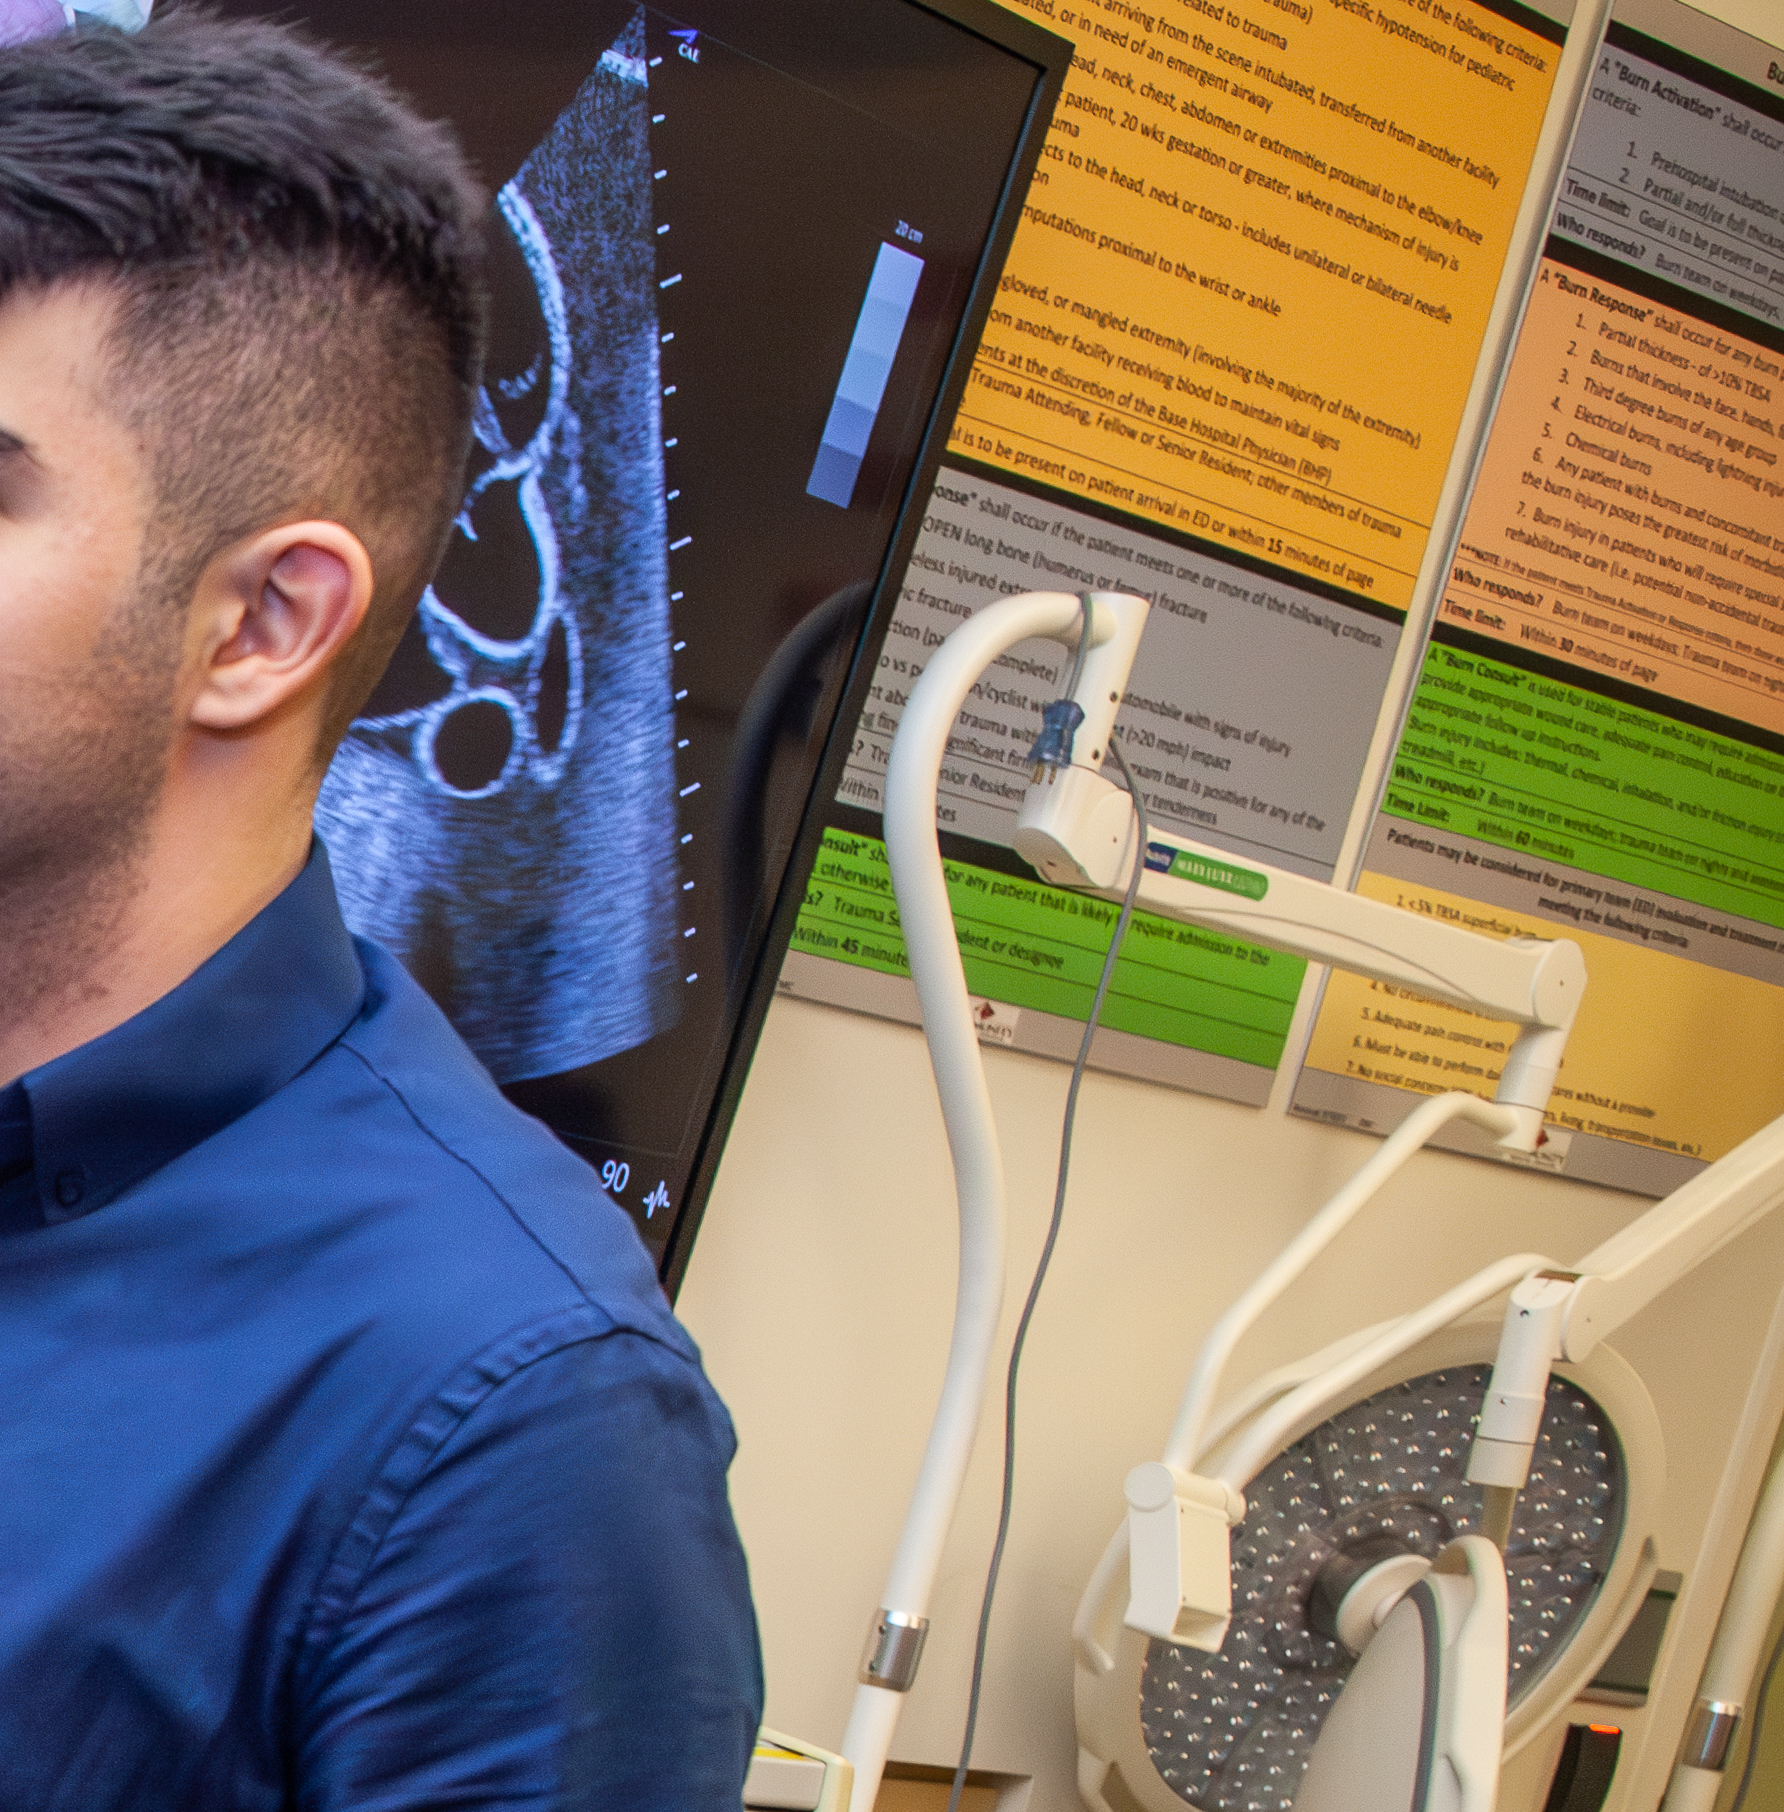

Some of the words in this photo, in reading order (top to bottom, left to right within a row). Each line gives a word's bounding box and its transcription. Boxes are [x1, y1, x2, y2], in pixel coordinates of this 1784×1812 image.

[1060, 10, 1074, 25] or
[1078, 14, 1091, 32] in
[1094, 24, 1128, 48] need
[1130, 40, 1146, 55] of
[1147, 48, 1164, 63] an
[1166, 56, 1229, 92] emergent
[1231, 83, 1273, 114] airway
[1226, 11, 1240, 28] to
[1242, 18, 1287, 50] trauma
[1376, 12, 1447, 57] hypotension
[1448, 47, 1465, 66] for
[1466, 58, 1515, 91] pediatric
[1417, 0, 1431, 13] of
[1432, 4, 1452, 24] the
[1453, 15, 1505, 54] following
[1157, 17, 1189, 44] from
[1192, 34, 1214, 55] the
[1215, 48, 1252, 73] scene
[1254, 61, 1315, 105] intubated,
[1320, 92, 1387, 133] transferred
[1387, 122, 1416, 147] from
[1417, 139, 1463, 168] another
[1463, 157, 1500, 189] facility
[1600, 57, 1609, 74] A
[1615, 62, 1650, 91] "Burn
[1651, 80, 1720, 119] Activation"
[1722, 113, 1750, 136] shall
[1068, 51, 1097, 79] ead,
[1102, 67, 1135, 94] neck,
[1140, 83, 1177, 112] chest,
[1181, 101, 1241, 136] abdomen
[1243, 130, 1257, 143] or
[1260, 136, 1327, 175] extremities
[1328, 166, 1381, 198] proximal
[1382, 188, 1395, 205] to
[1397, 195, 1416, 215] the
[1065, 92, 1116, 126] patient,
[1120, 112, 1138, 132] 20
[1141, 123, 1165, 144] wks
[1166, 135, 1226, 169] gestation
[1228, 162, 1242, 176] or
[1243, 168, 1291, 199] greater,
[1296, 190, 1333, 216] where
[1335, 207, 1400, 245] mechanism
[1402, 237, 1415, 250] of
[1416, 240, 1448, 269] injury
[1449, 255, 1459, 272] is
[1643, 178, 1684, 207] Partial
[1684, 199, 1725, 226] and/or
[1726, 213, 1746, 233] full
[1651, 151, 1719, 192] Prehospital
[1719, 181, 1779, 219] intubation
[1020, 201, 1096, 243] mputations
[1097, 235, 1157, 267] proximal
[1158, 256, 1172, 273] to
[1175, 263, 1196, 283] the
[1199, 275, 1230, 296] wrist
[1231, 288, 1246, 301] or
[1247, 294, 1281, 316] ankle
[1041, 139, 1064, 162] cts
[1068, 151, 1082, 169] to
[1085, 158, 1107, 179] the
[1110, 167, 1145, 197] head,
[1149, 187, 1179, 208] neck
[1182, 201, 1196, 214] or
[1198, 206, 1232, 230] torso
[1242, 223, 1291, 255] includes
[1294, 247, 1350, 279] unilateral
[1351, 272, 1364, 285] or
[1366, 275, 1414, 306] bilateral
[1414, 299, 1452, 324] needle
[1557, 212, 1585, 235] Who
[1586, 228, 1645, 259] responds?
[1540, 268, 1549, 283] A
[1554, 272, 1588, 298] "Burn
[1589, 288, 1653, 322] Response"
[1654, 315, 1681, 335] shall
[1682, 329, 1712, 348] occur
[1714, 338, 1731, 355] for
[1732, 349, 1752, 367] any
[1753, 354, 1779, 376] burn
[1002, 274, 1049, 305] gloved,
[1053, 295, 1069, 309] or
[1071, 302, 1129, 333] mangled
[1130, 324, 1191, 360] extremity
[1193, 346, 1252, 384] (involving
[1254, 371, 1275, 390] the
[1277, 381, 1326, 412] majority
[1327, 400, 1341, 415] of
[1342, 405, 1361, 424] the
[1363, 416, 1421, 450] extremity)
[1566, 432, 1619, 463] Chemical
[1620, 452, 1652, 476] burns
[921, 516, 962, 541] OPEN
[964, 529, 994, 555] long
[996, 539, 1030, 564] bone
[1032, 552, 1095, 585] (humerus
[1097, 576, 1111, 591] or
[948, 561, 997, 590] injured
[916, 588, 972, 619] fracture
[1159, 593, 1207, 623] fracture
[841, 937, 859, 954] 45
[861, 945, 909, 967] minute
[602, 1159, 630, 1194] 90
